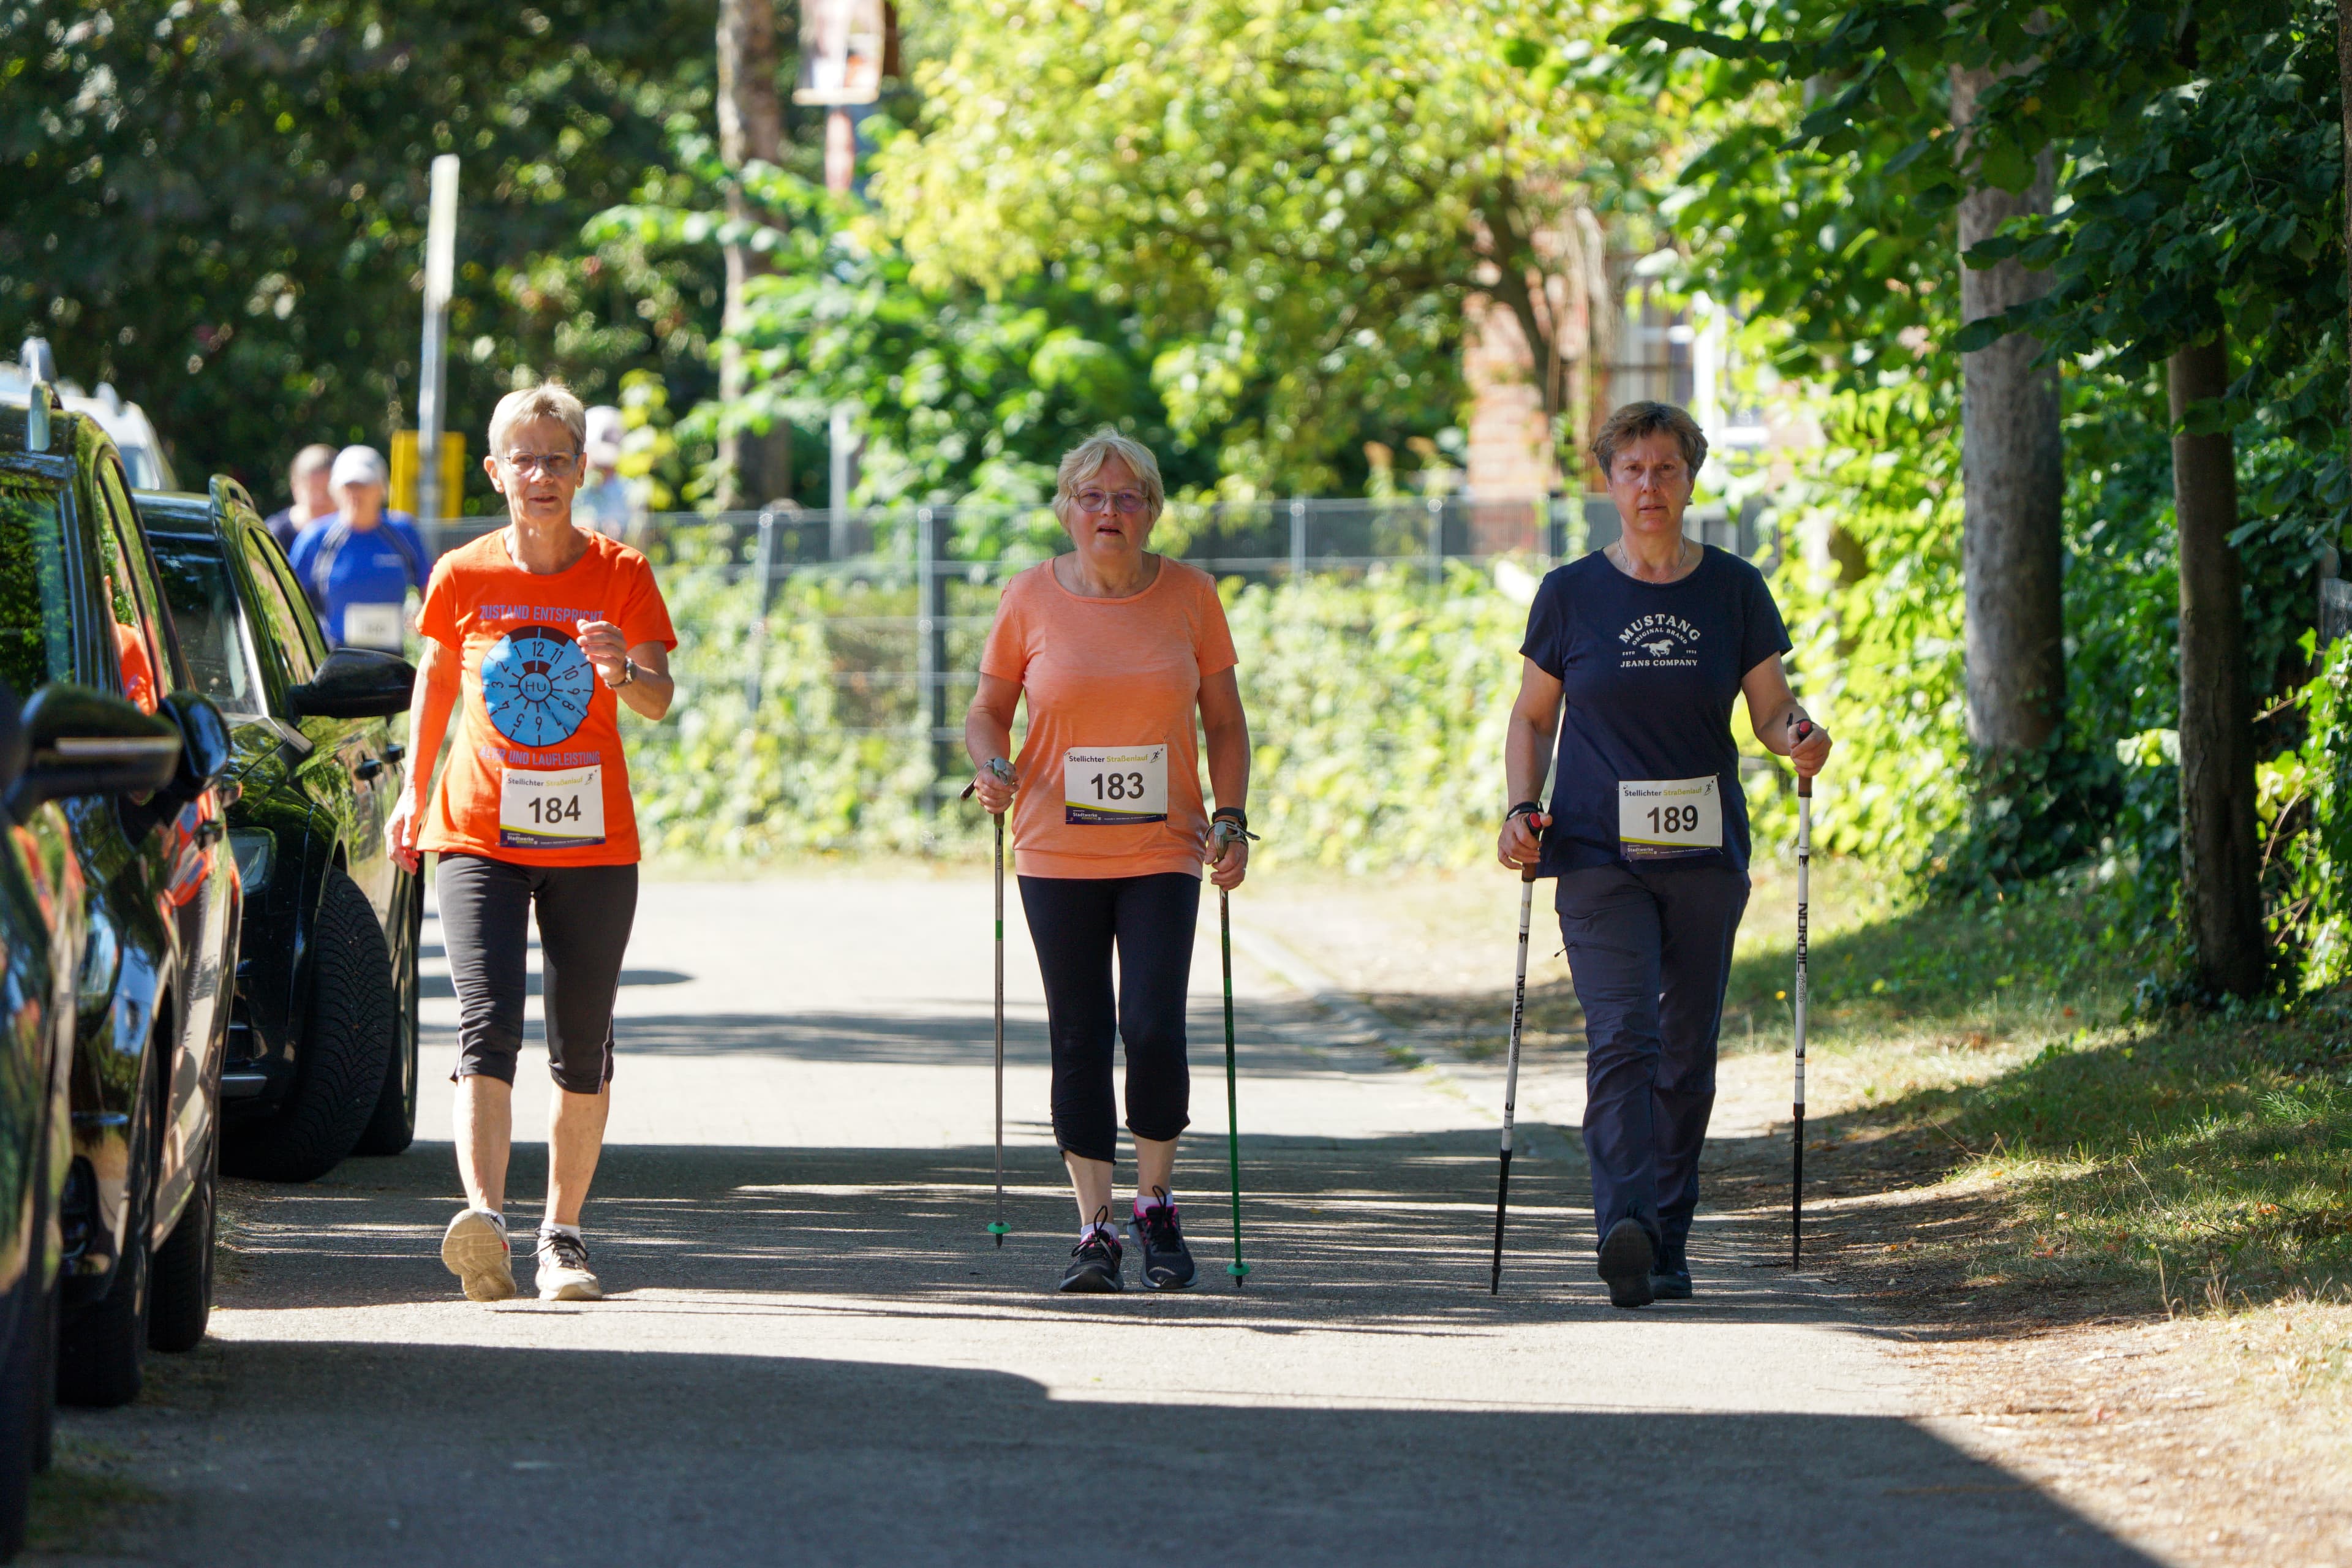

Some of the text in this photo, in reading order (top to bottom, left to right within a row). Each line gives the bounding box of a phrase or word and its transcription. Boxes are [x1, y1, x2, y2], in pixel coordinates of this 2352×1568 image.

[480, 605, 604, 622] ZUSTAND ENTSPRICHT
[1619, 614, 1701, 643] MUSTANG
[1632, 627, 1687, 646] ORIGINAL BRAND
[513, 645, 522, 658] 1
[532, 641, 545, 657] 12
[550, 647, 564, 665] 11
[496, 661, 510, 673] 2
[562, 665, 579, 680] 10
[525, 680, 546, 692] HU
[498, 700, 510, 710] 4
[562, 700, 575, 710] 8
[513, 714, 525, 728] 5
[510, 752, 529, 764] UND
[532, 751, 600, 765] LAUFLEISTUNG
[1107, 754, 1148, 763] Straßenlauf
[508, 776, 582, 786] Stellichter Straßenlauf
[1091, 772, 1144, 800] 183
[1663, 786, 1702, 796] Straßenlauf
[529, 795, 581, 824] 184
[1647, 805, 1698, 834] 189
[1798, 902, 1807, 973] NORDIC
